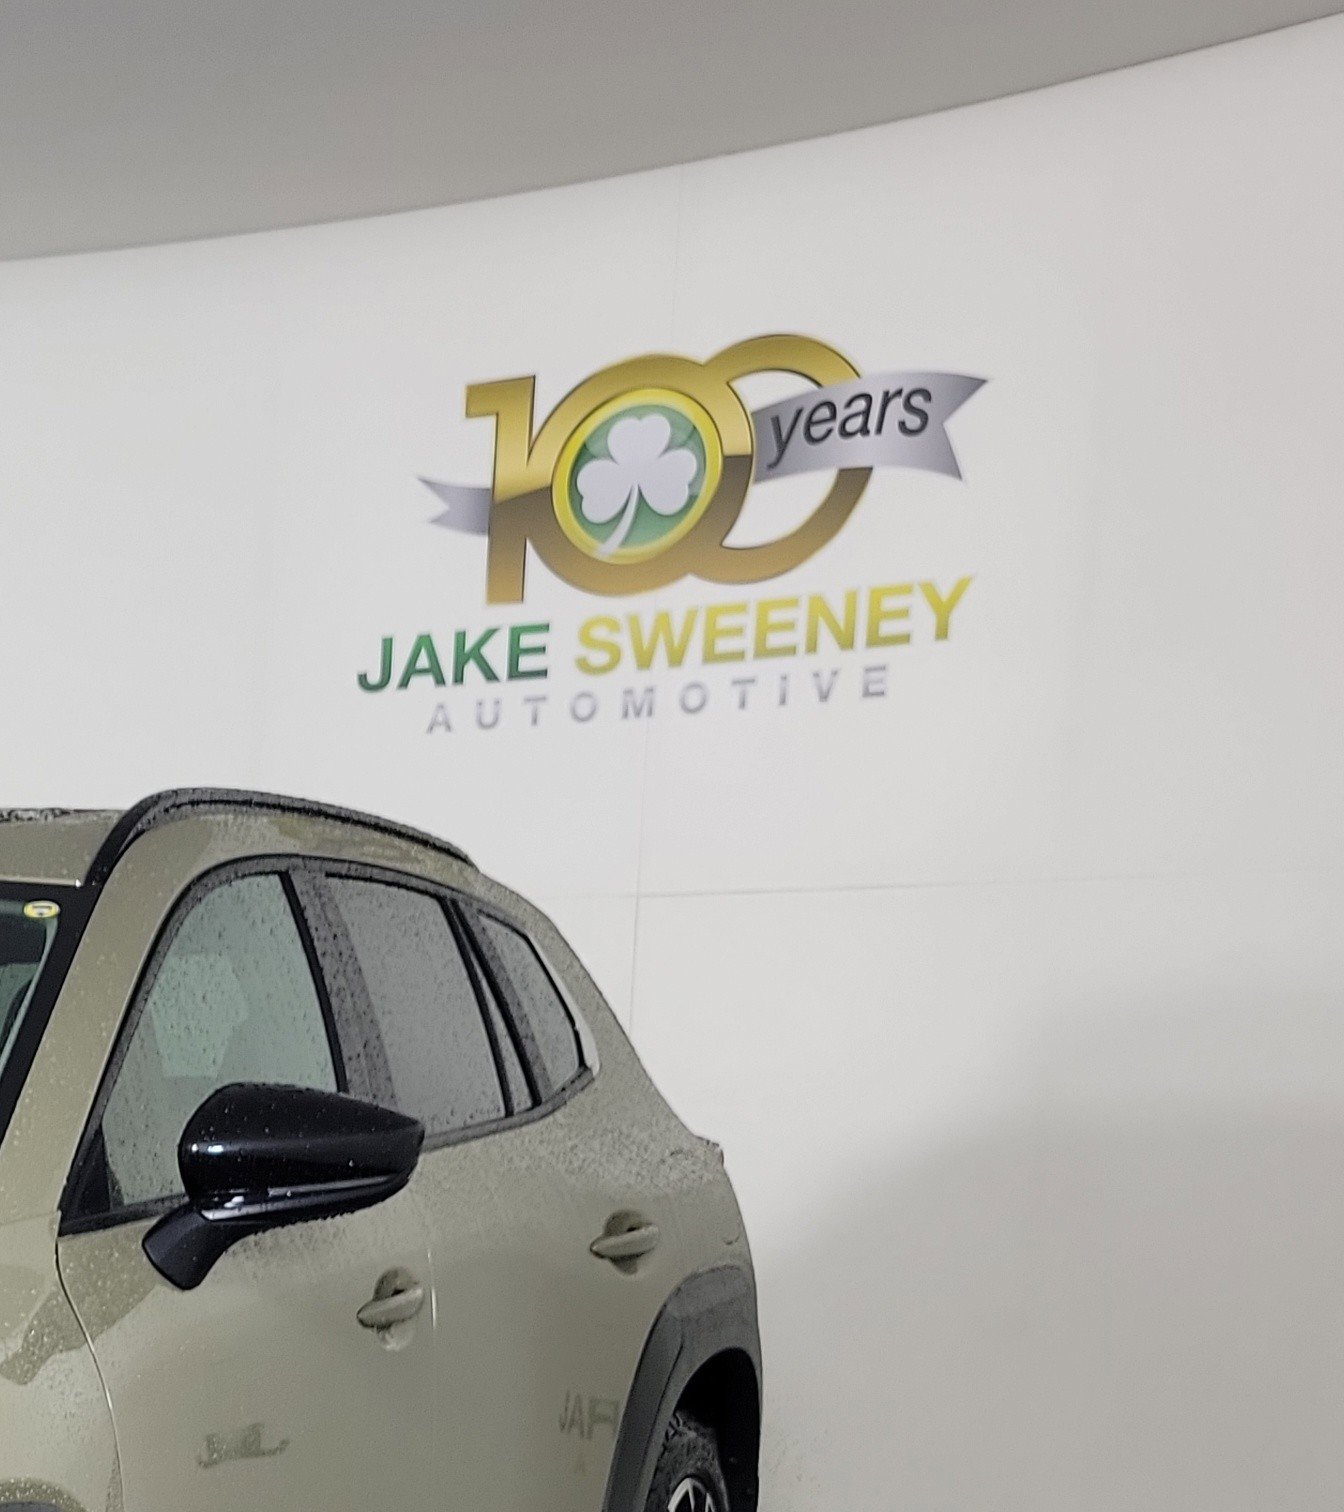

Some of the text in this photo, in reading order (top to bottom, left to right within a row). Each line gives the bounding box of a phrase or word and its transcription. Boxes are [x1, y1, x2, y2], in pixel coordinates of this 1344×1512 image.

[464, 333, 933, 605] 100 years
[356, 575, 974, 695] JAKE SWEENEY
[425, 663, 890, 735] AUTOMOTIVE
